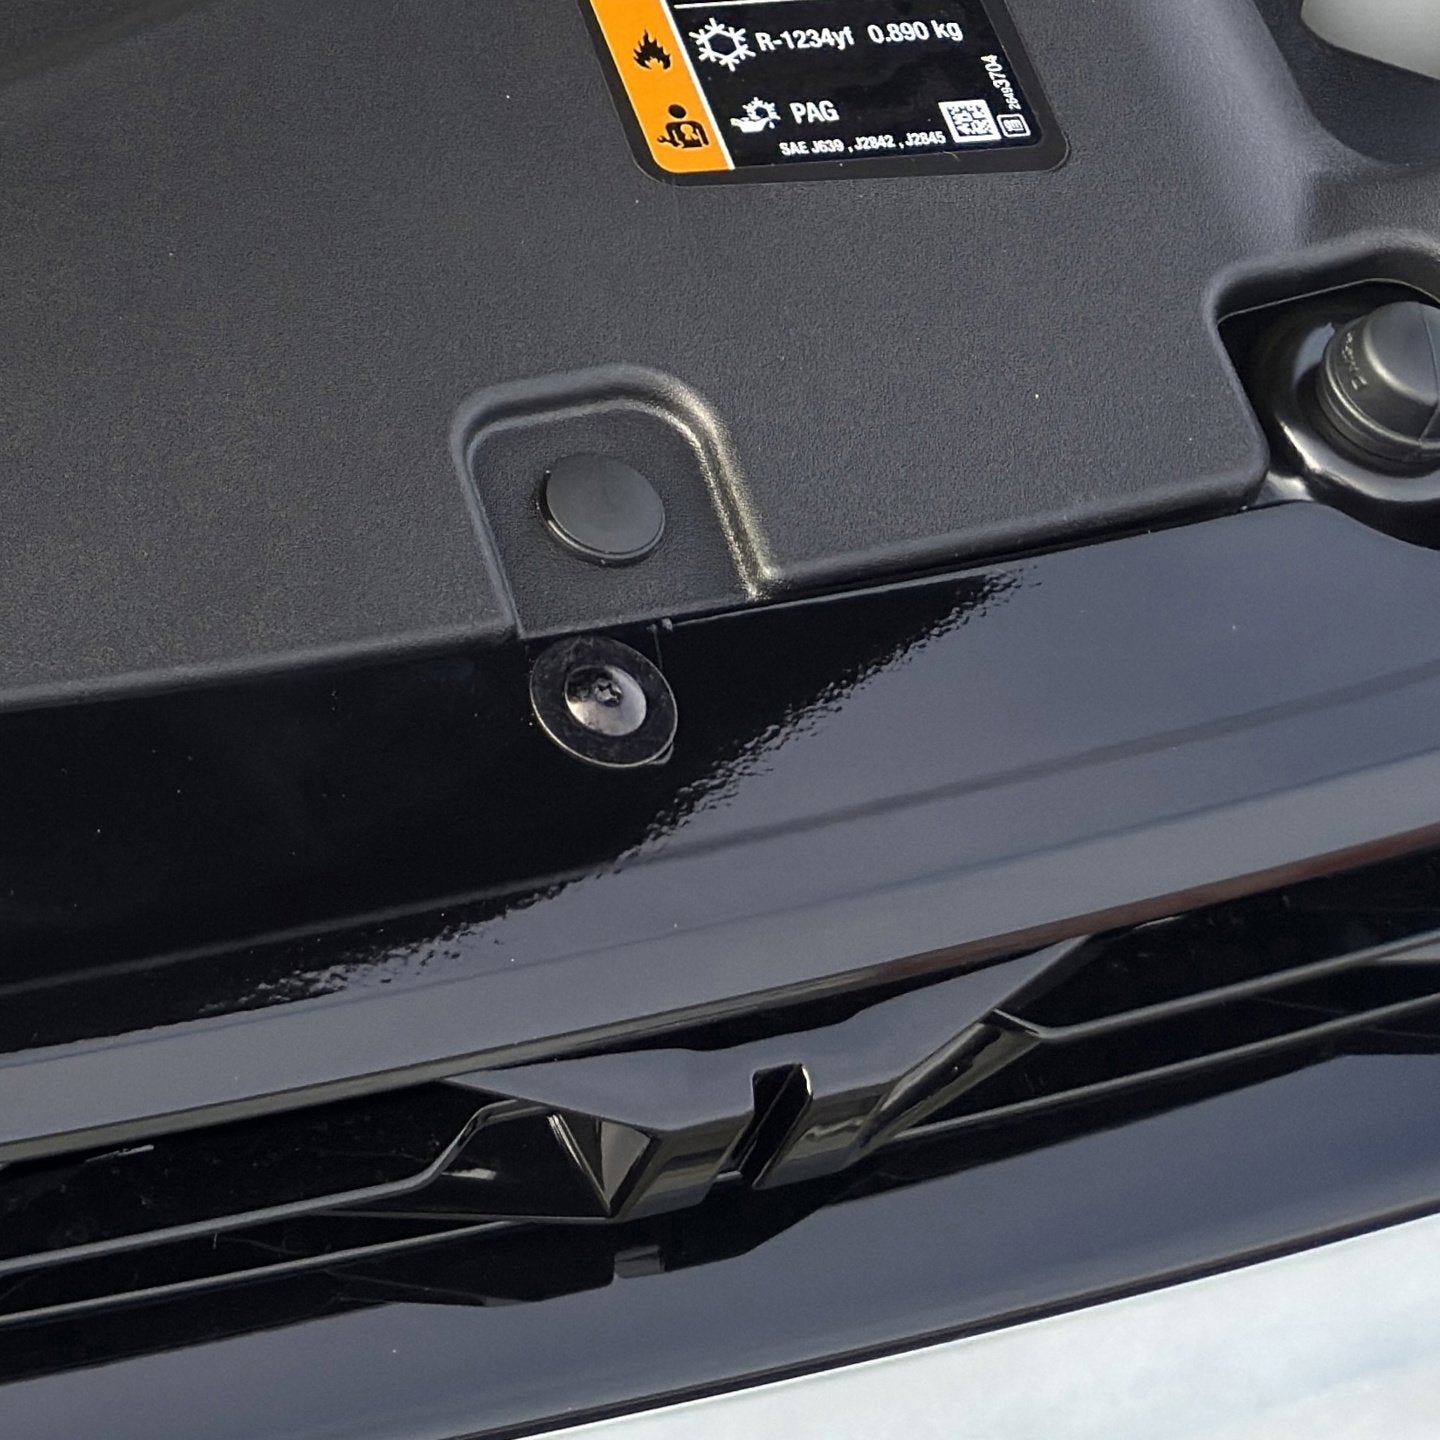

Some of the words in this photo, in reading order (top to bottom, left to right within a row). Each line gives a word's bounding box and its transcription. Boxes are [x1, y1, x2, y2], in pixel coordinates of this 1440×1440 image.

[756, 28, 855, 53] R-1234yf
[867, 22, 929, 45] 0.890
[932, 17, 963, 43] kg
[788, 100, 840, 123] PAG
[779, 141, 810, 156] SAE
